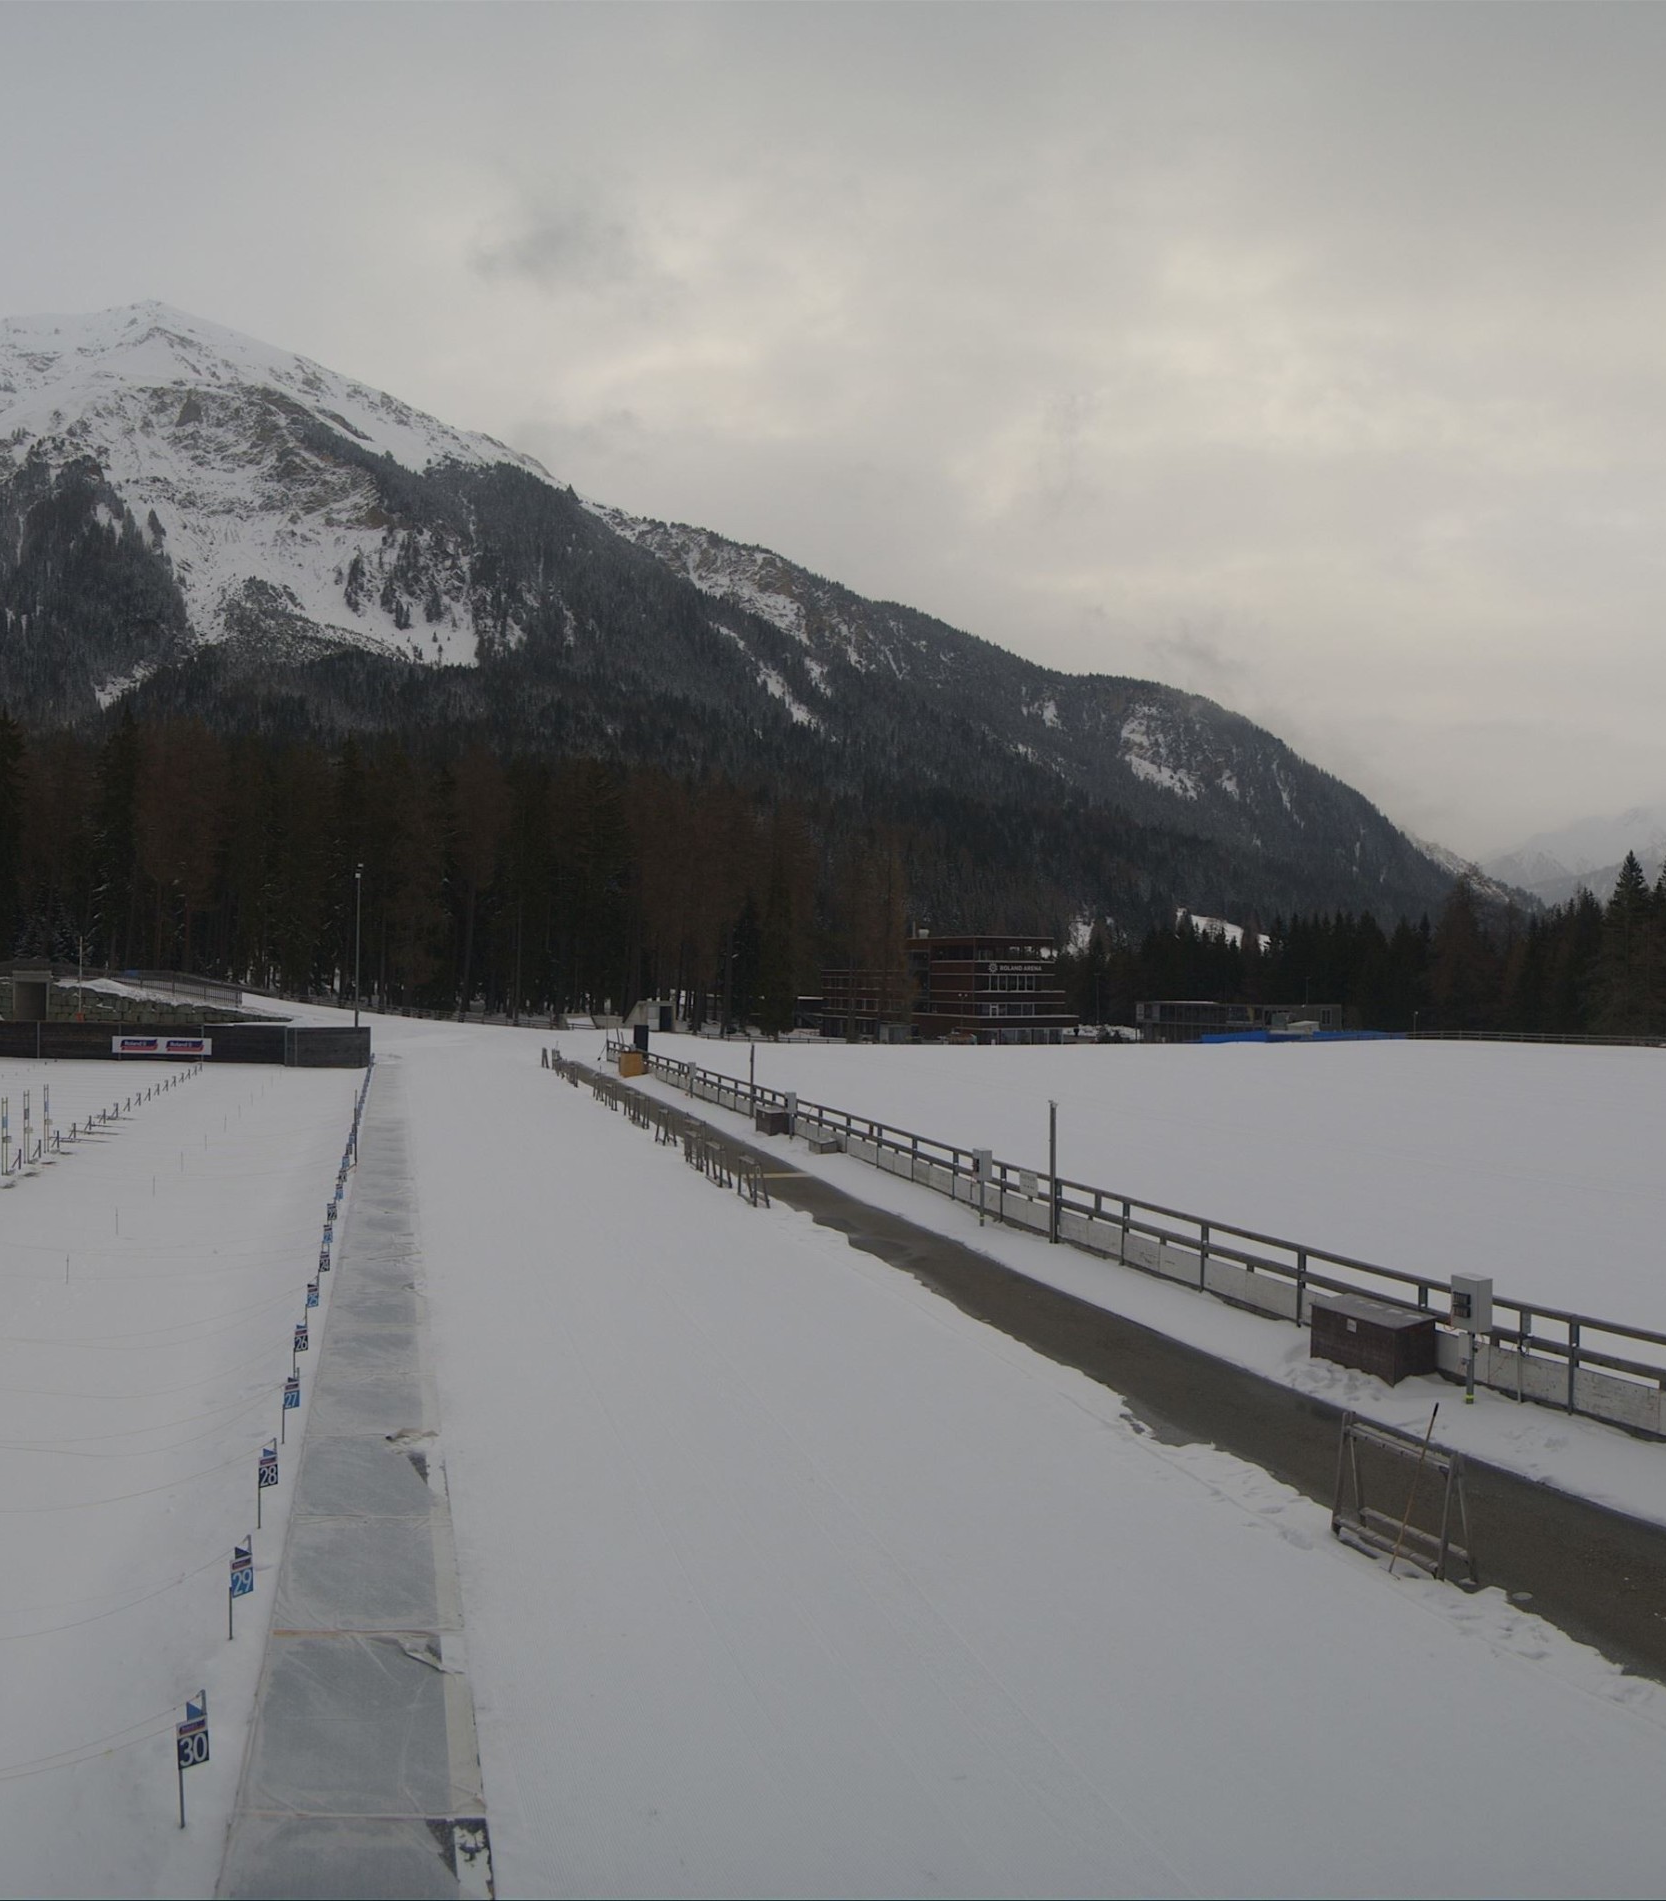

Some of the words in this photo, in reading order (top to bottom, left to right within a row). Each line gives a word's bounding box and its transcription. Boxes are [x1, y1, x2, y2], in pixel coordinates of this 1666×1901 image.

[295, 1335, 308, 1351] 26
[285, 1392, 298, 1408] 27
[260, 1465, 277, 1487] 28
[232, 1569, 252, 1596] 29
[179, 1732, 208, 1767] 30
